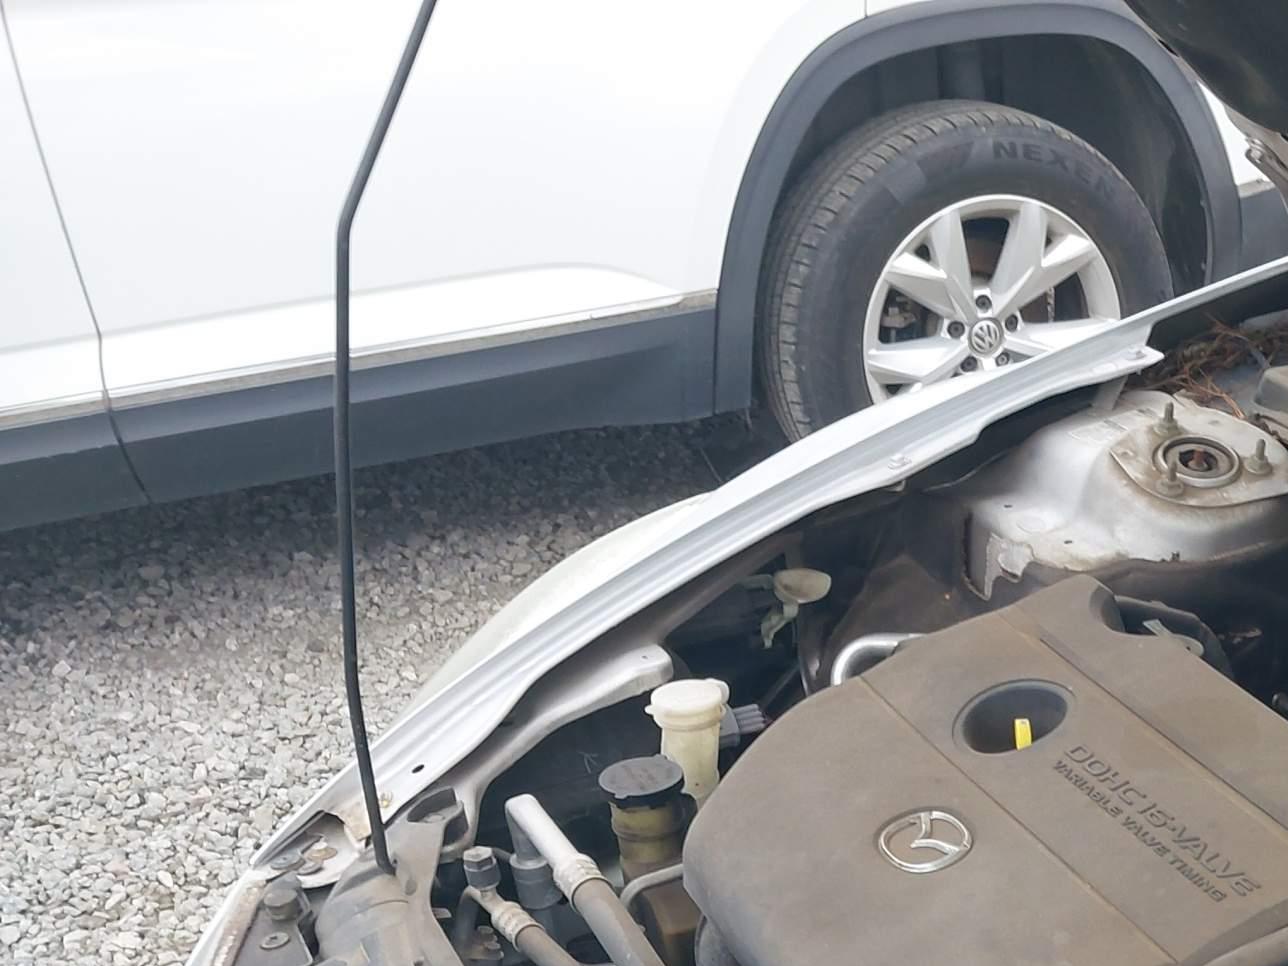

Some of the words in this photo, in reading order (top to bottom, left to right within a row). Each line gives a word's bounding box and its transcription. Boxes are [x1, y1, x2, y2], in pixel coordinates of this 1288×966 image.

[992, 140, 1115, 198] NEXEN
[1052, 759, 1124, 819] VARIABLE
[1120, 814, 1171, 858] VALVE
[1168, 856, 1229, 904] TIMING
[1064, 744, 1148, 807] DOHC
[1137, 801, 1263, 898] 16-VALVE
